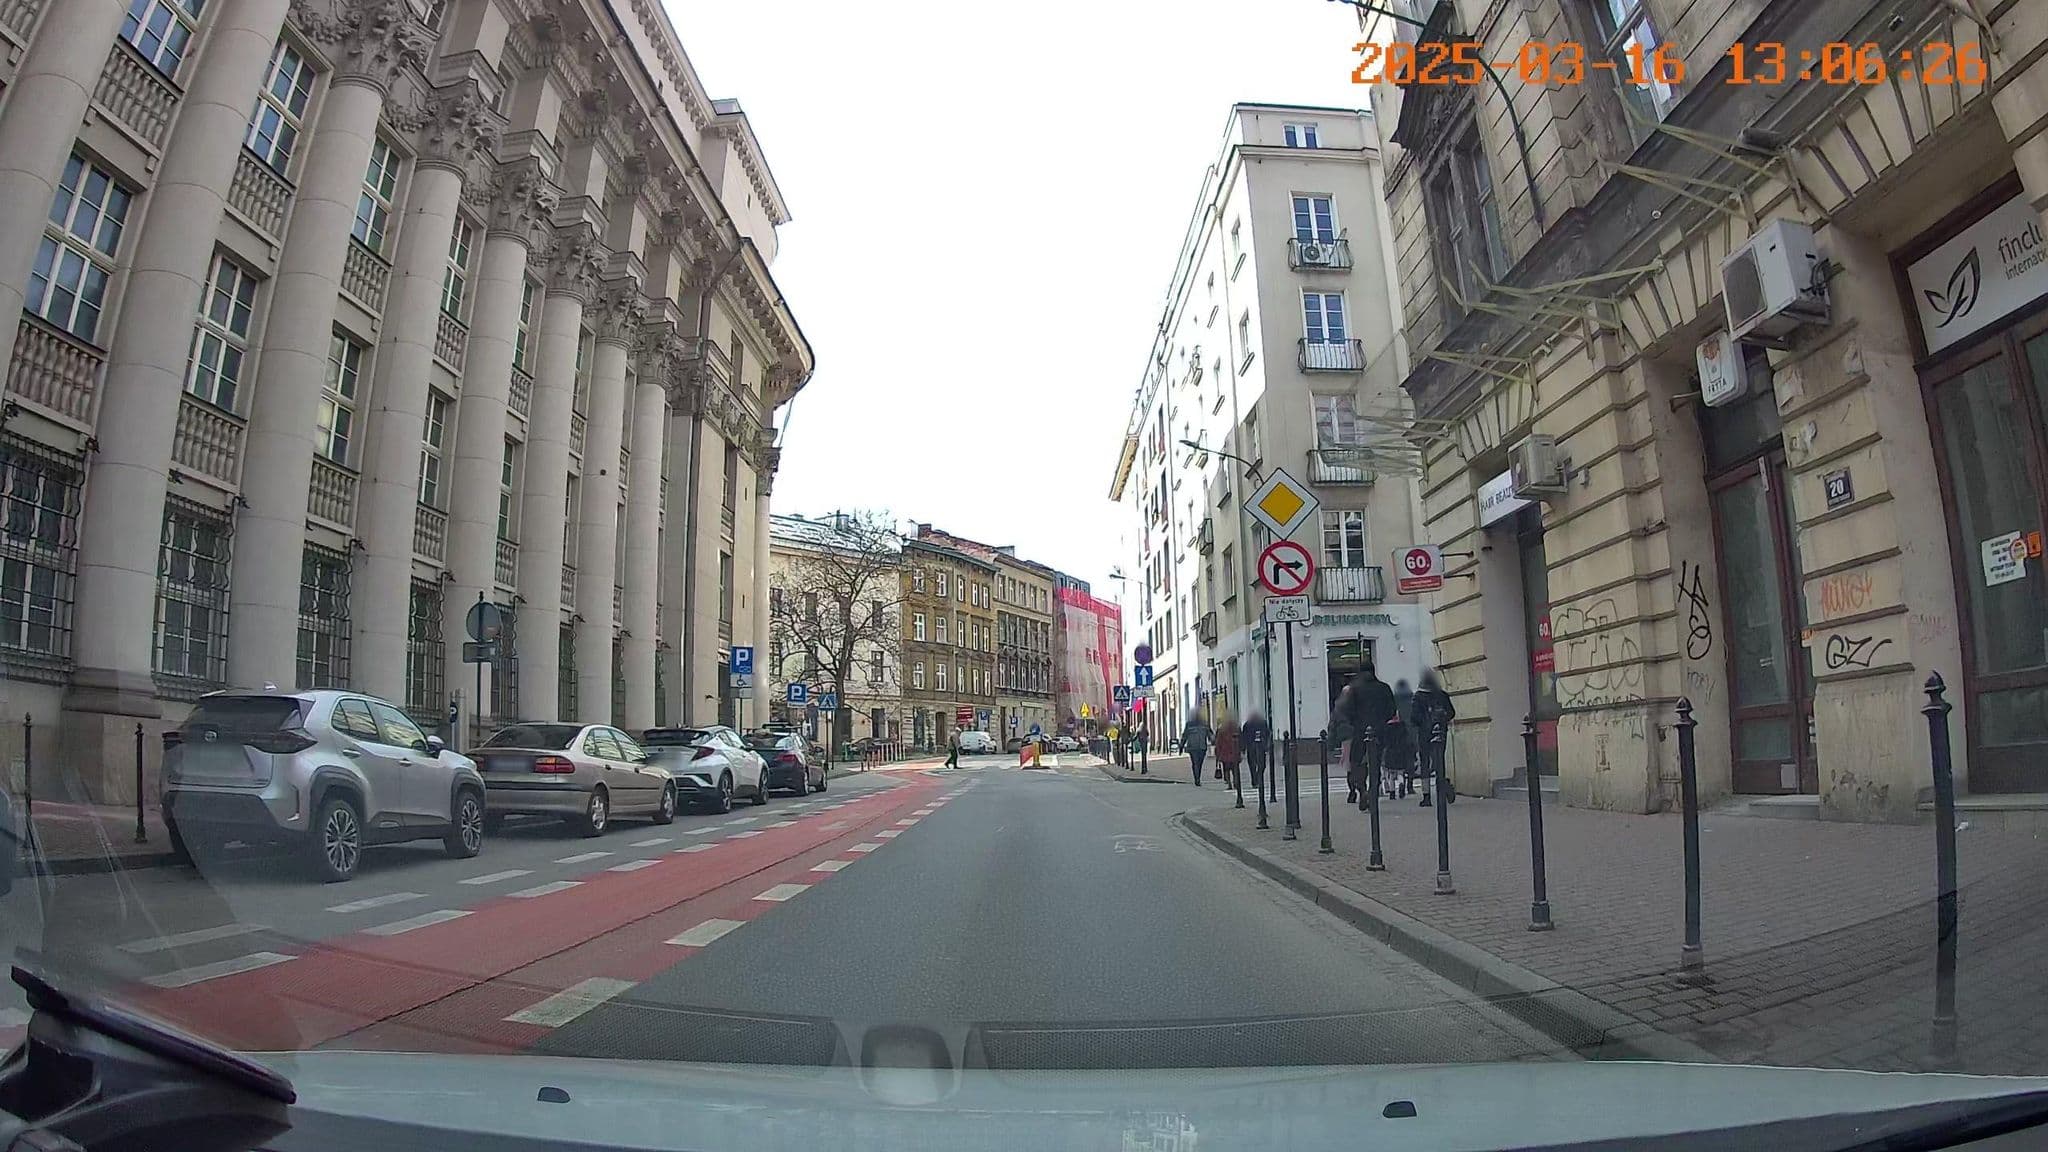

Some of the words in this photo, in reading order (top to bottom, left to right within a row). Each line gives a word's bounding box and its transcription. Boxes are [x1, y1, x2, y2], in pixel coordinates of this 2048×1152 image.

[1830, 480, 1844, 498] 20
[1314, 613, 1390, 626] DELIKATESY
[735, 648, 749, 666] P
[791, 685, 804, 700] P
